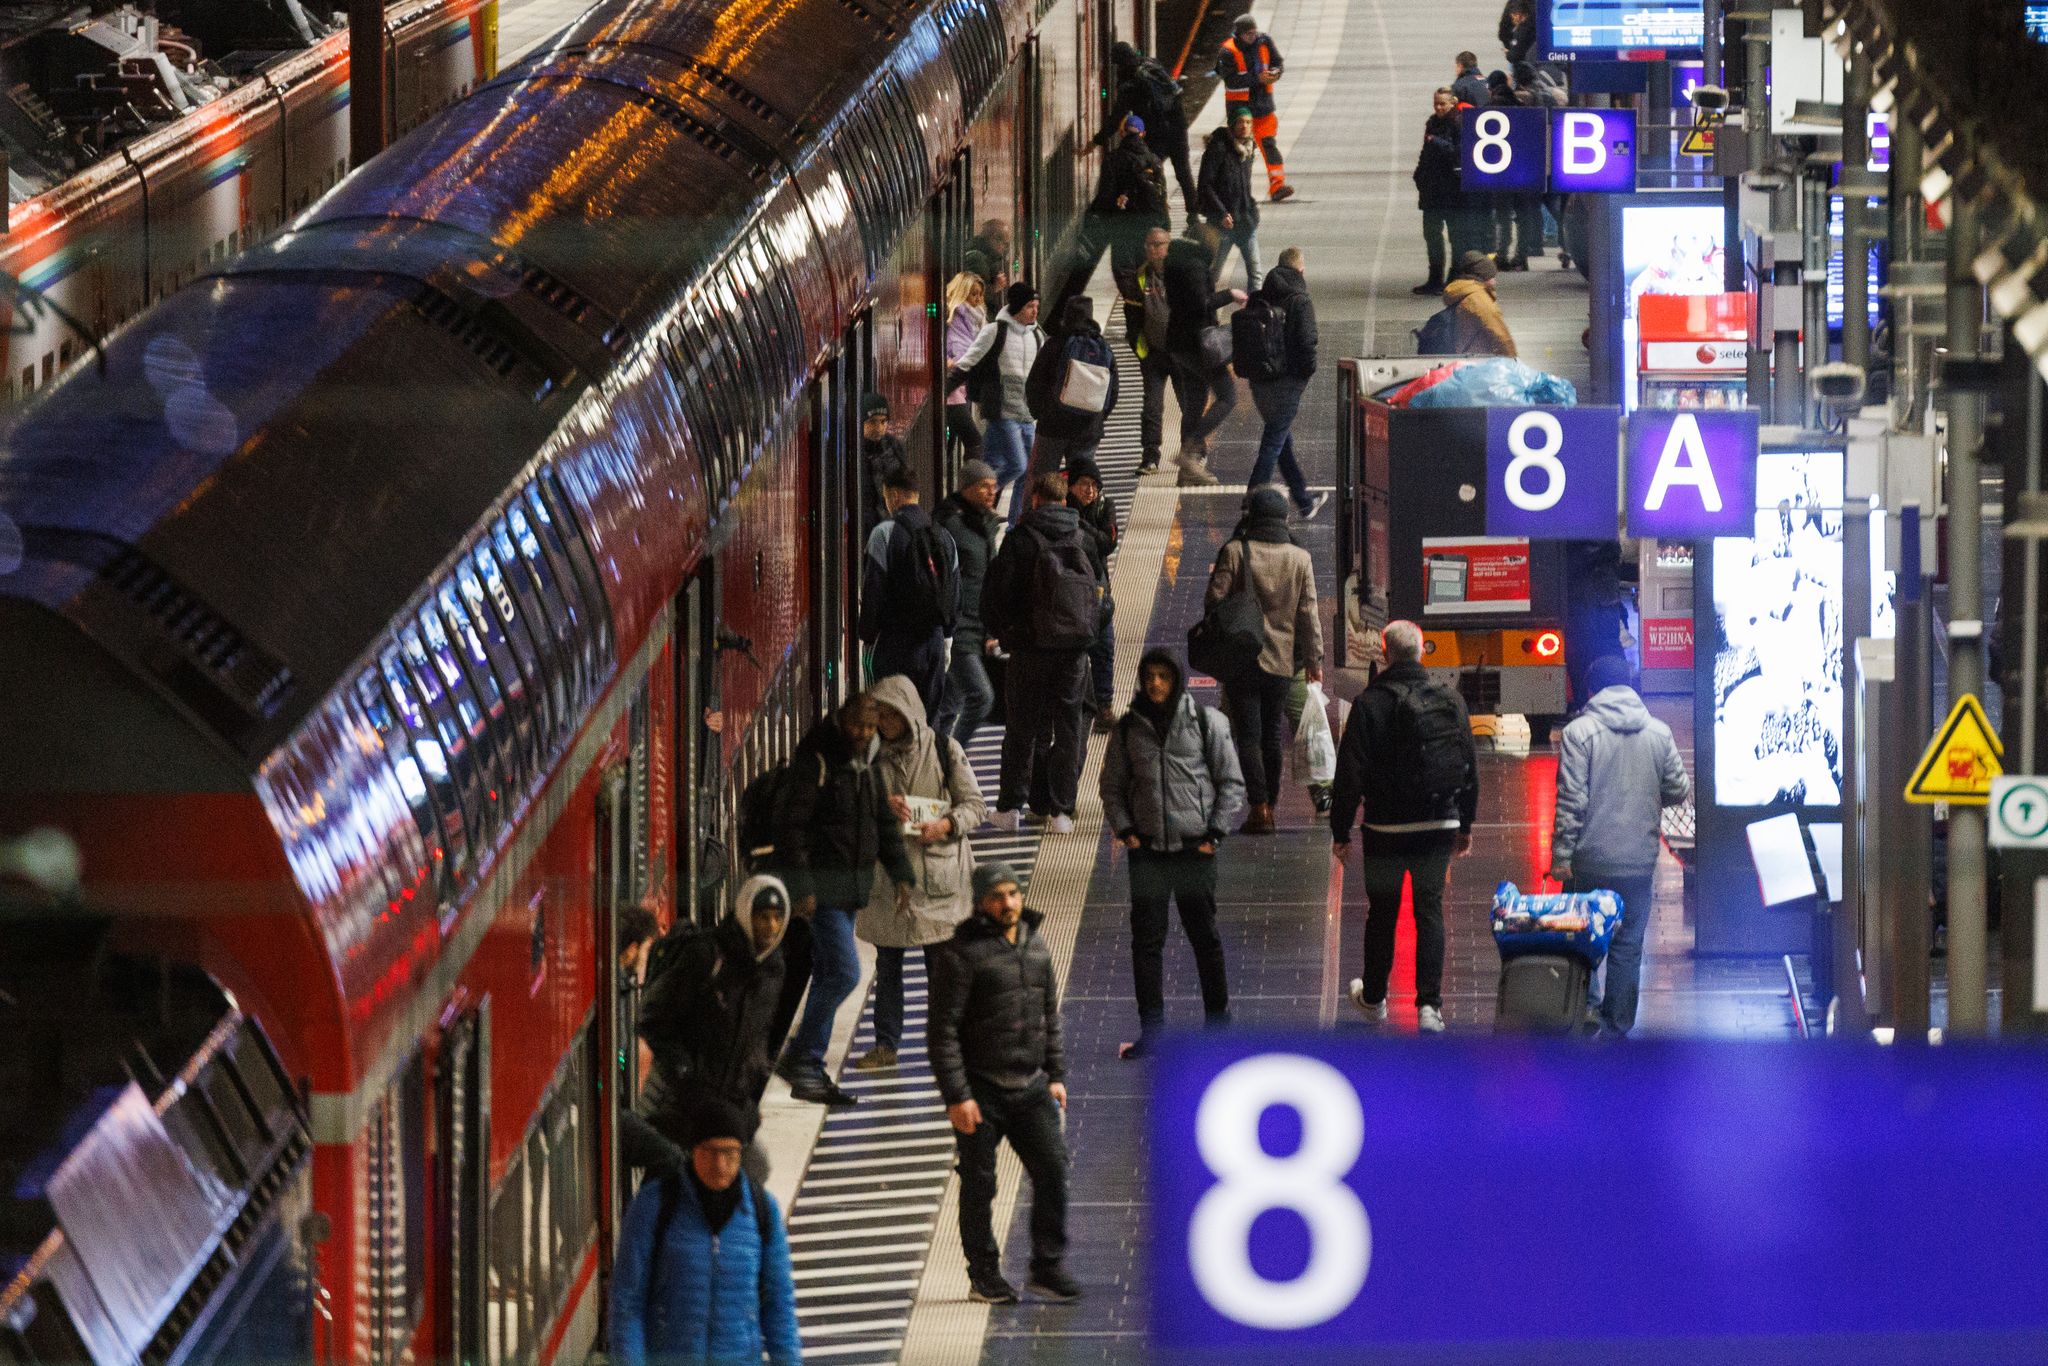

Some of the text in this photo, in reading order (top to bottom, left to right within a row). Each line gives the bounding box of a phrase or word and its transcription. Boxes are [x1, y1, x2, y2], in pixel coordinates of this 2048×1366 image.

[1548, 52, 1576, 61] Gleis 8
[1473, 111, 1606, 174] 8 B
[1504, 411, 1722, 512] 8 A
[1189, 1054, 1371, 1329] 8
